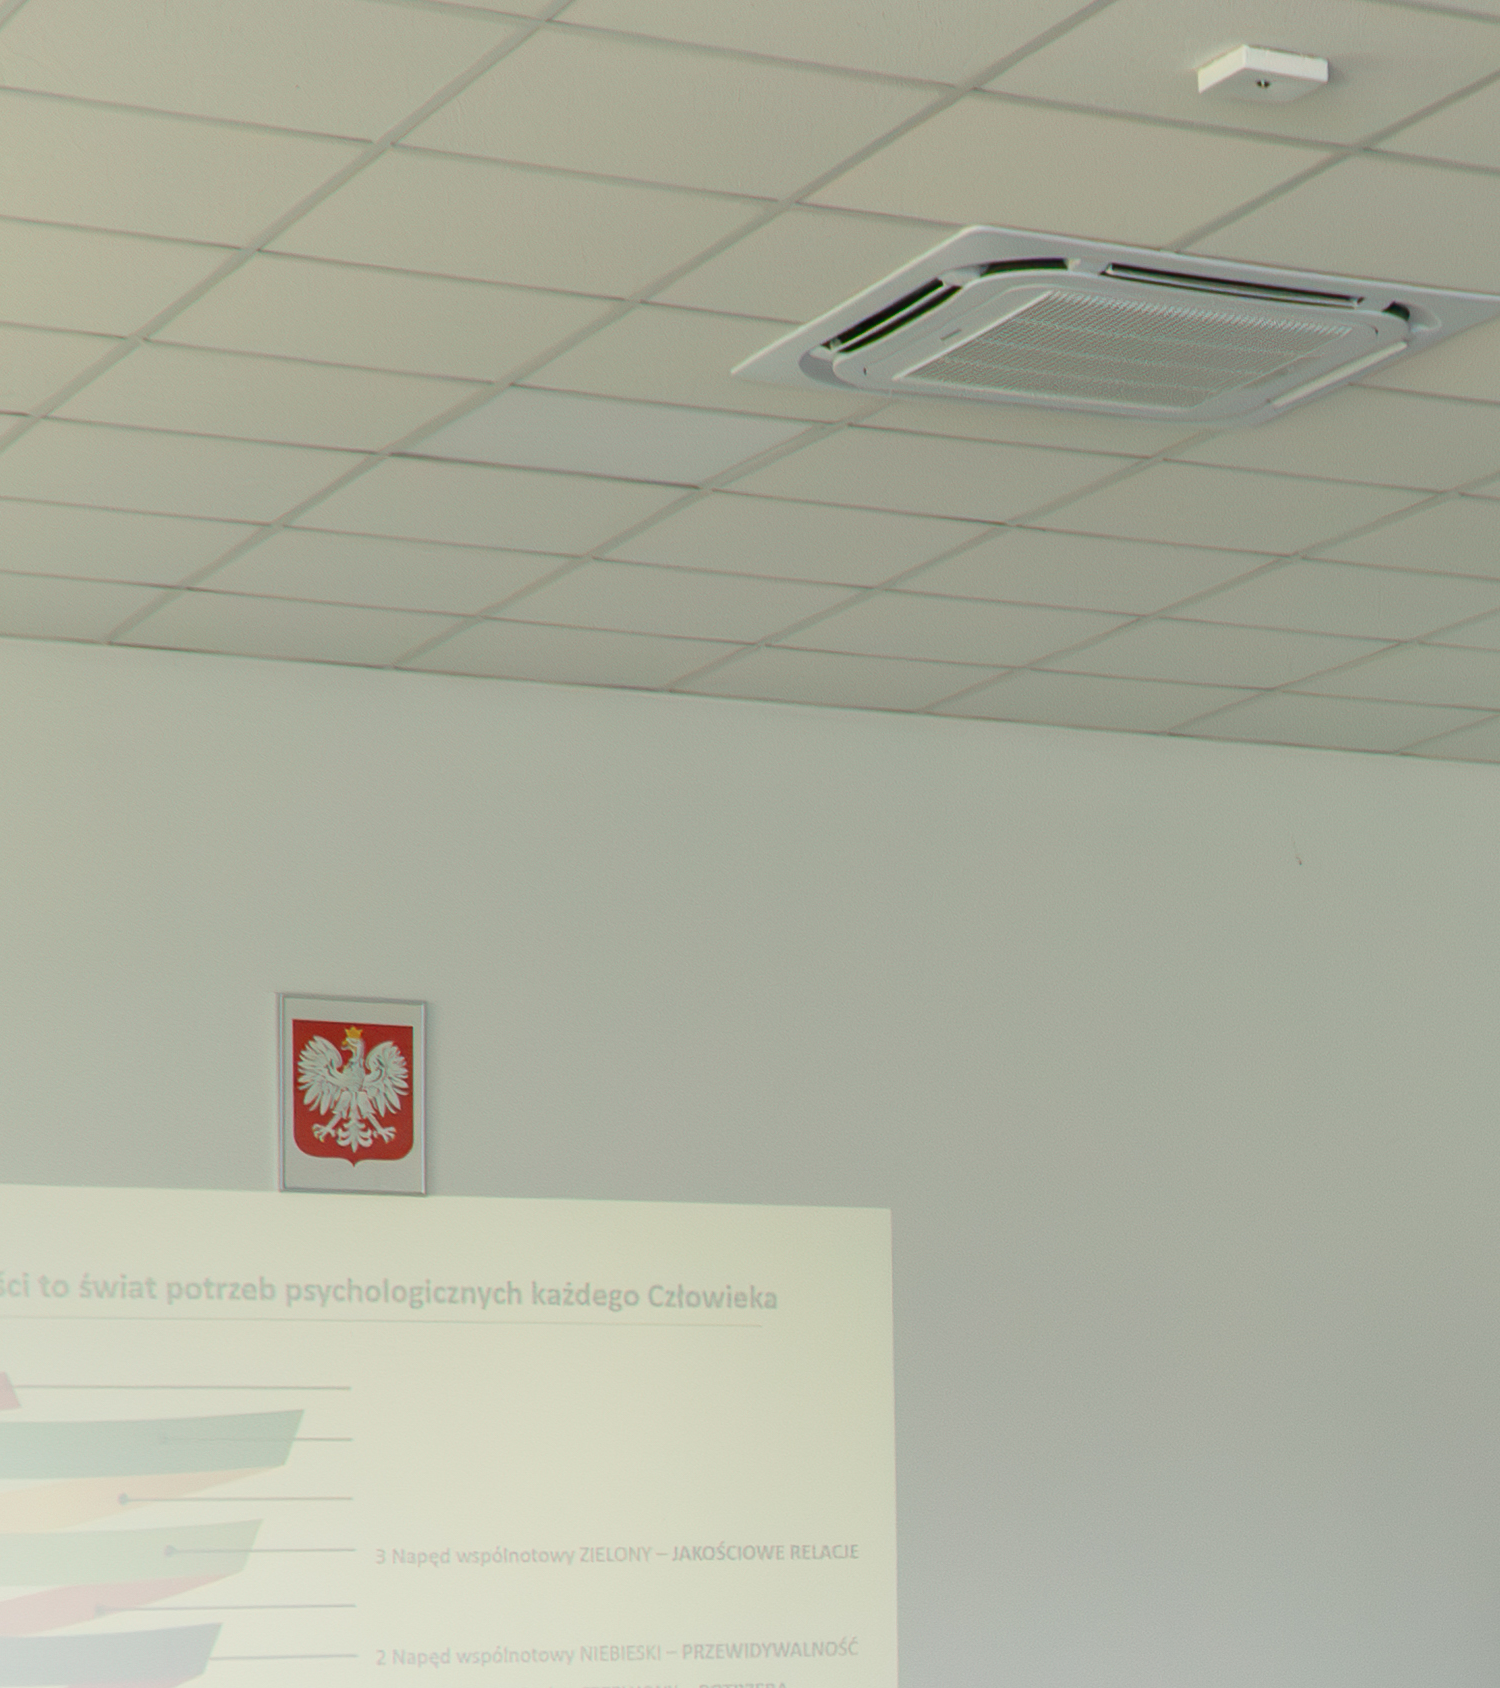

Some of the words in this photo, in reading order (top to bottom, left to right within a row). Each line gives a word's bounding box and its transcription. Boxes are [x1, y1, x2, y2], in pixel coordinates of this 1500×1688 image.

[37, 1274, 70, 1299] to
[79, 1272, 158, 1300] świat
[165, 1275, 277, 1306] potrzeb
[285, 1277, 523, 1311] psychologicznych
[531, 1280, 641, 1313] każdego
[647, 1283, 778, 1310] Człowieka
[375, 1548, 387, 1565] 3
[391, 1547, 451, 1568] Napęd
[455, 1546, 576, 1567] wspólnotowy
[579, 1546, 653, 1563] ZIELONY
[671, 1540, 785, 1562] JAKOŚCIOWE
[790, 1543, 859, 1561] RELACJE
[376, 1649, 386, 1667] 2
[392, 1647, 451, 1669] Napęd
[455, 1645, 576, 1667] wspólnotowy
[580, 1644, 662, 1662] NIEBIESKI
[682, 1637, 859, 1660] PRZEWIDYWALNOŚĆ
